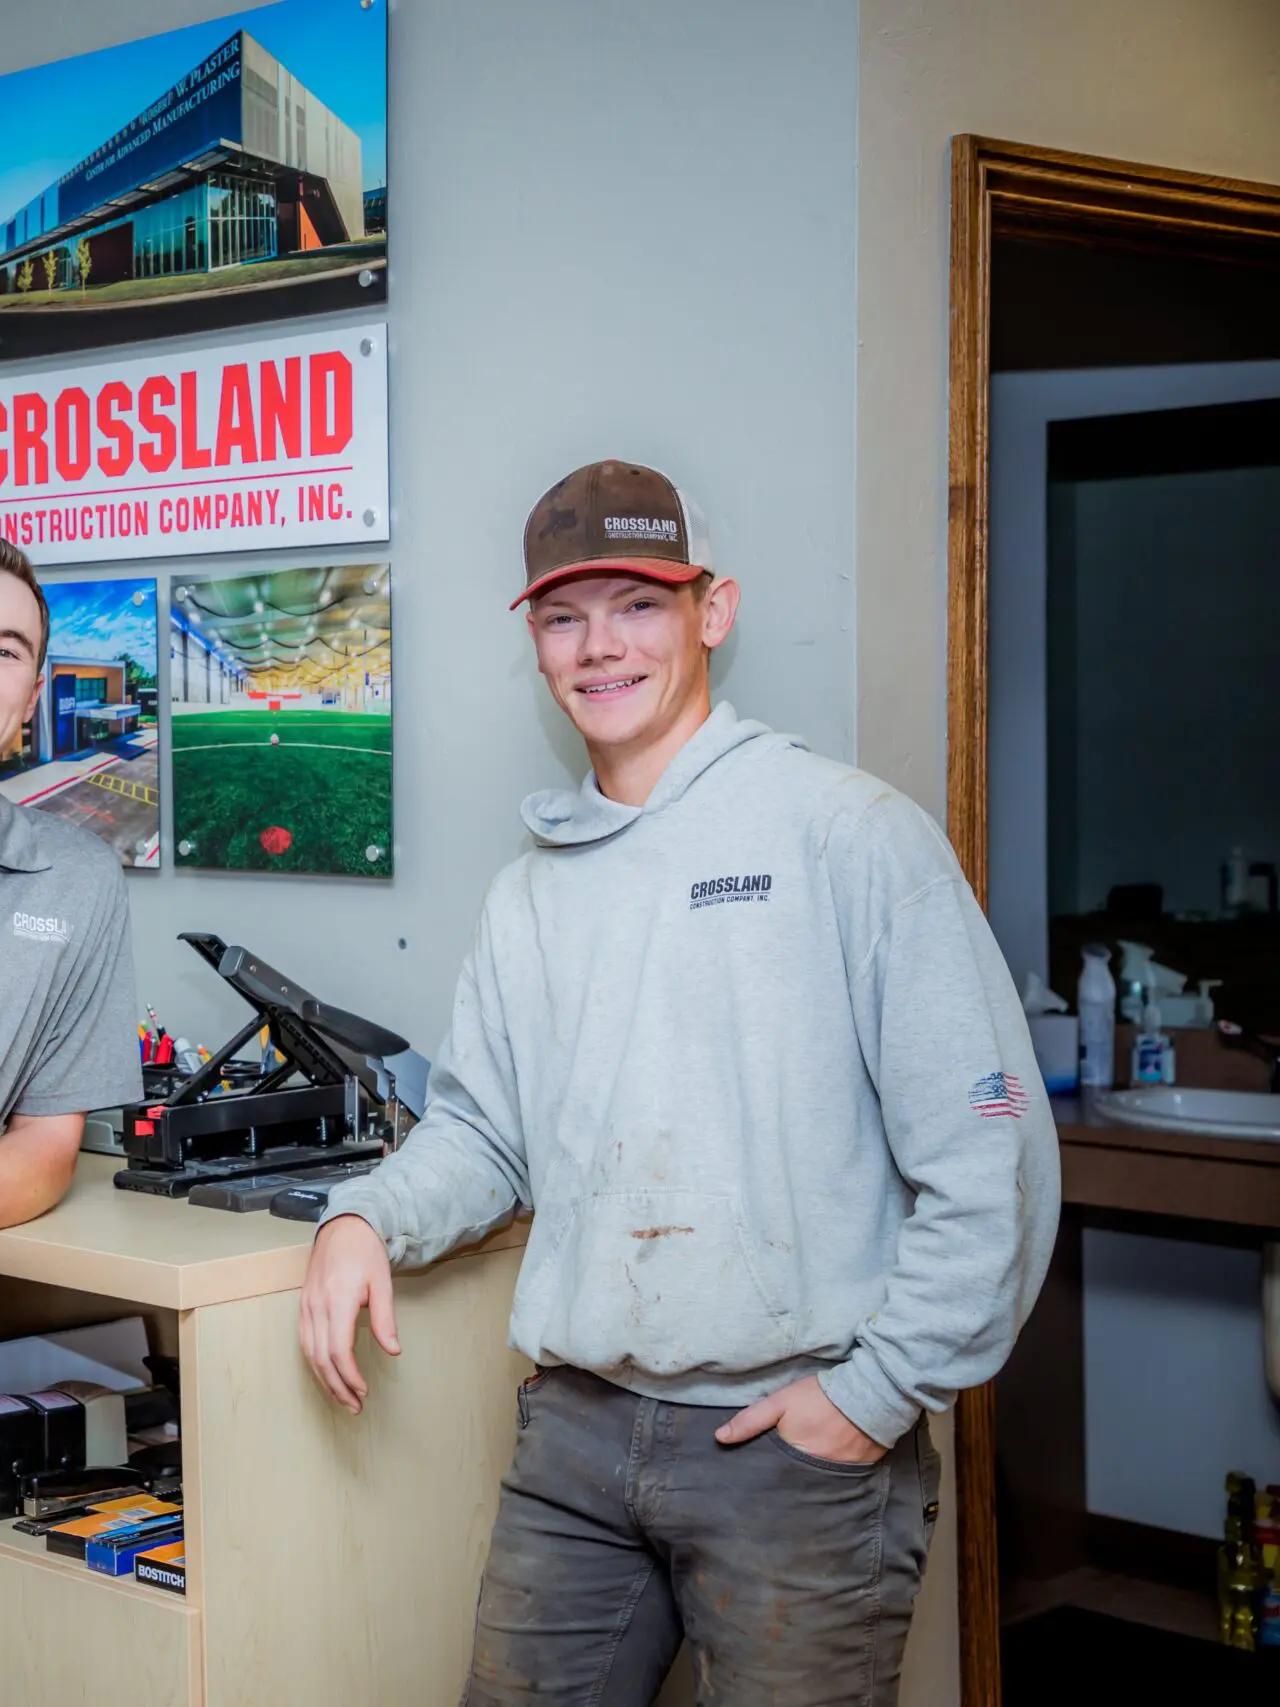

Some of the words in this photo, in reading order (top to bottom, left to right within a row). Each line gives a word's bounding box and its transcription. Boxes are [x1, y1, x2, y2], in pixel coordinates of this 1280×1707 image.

[189, 38, 240, 87] PLASTER
[152, 61, 240, 136] MANUFACTURING
[158, 489, 286, 534] COMPANY,
[297, 482, 353, 524] INC.
[604, 517, 677, 532] CROSSLAND
[690, 874, 772, 899] CROSSLAND
[689, 897, 725, 910] CONSTRUCTION
[756, 894, 770, 902] INC.
[138, 1564, 185, 1588] BOSTITCH
